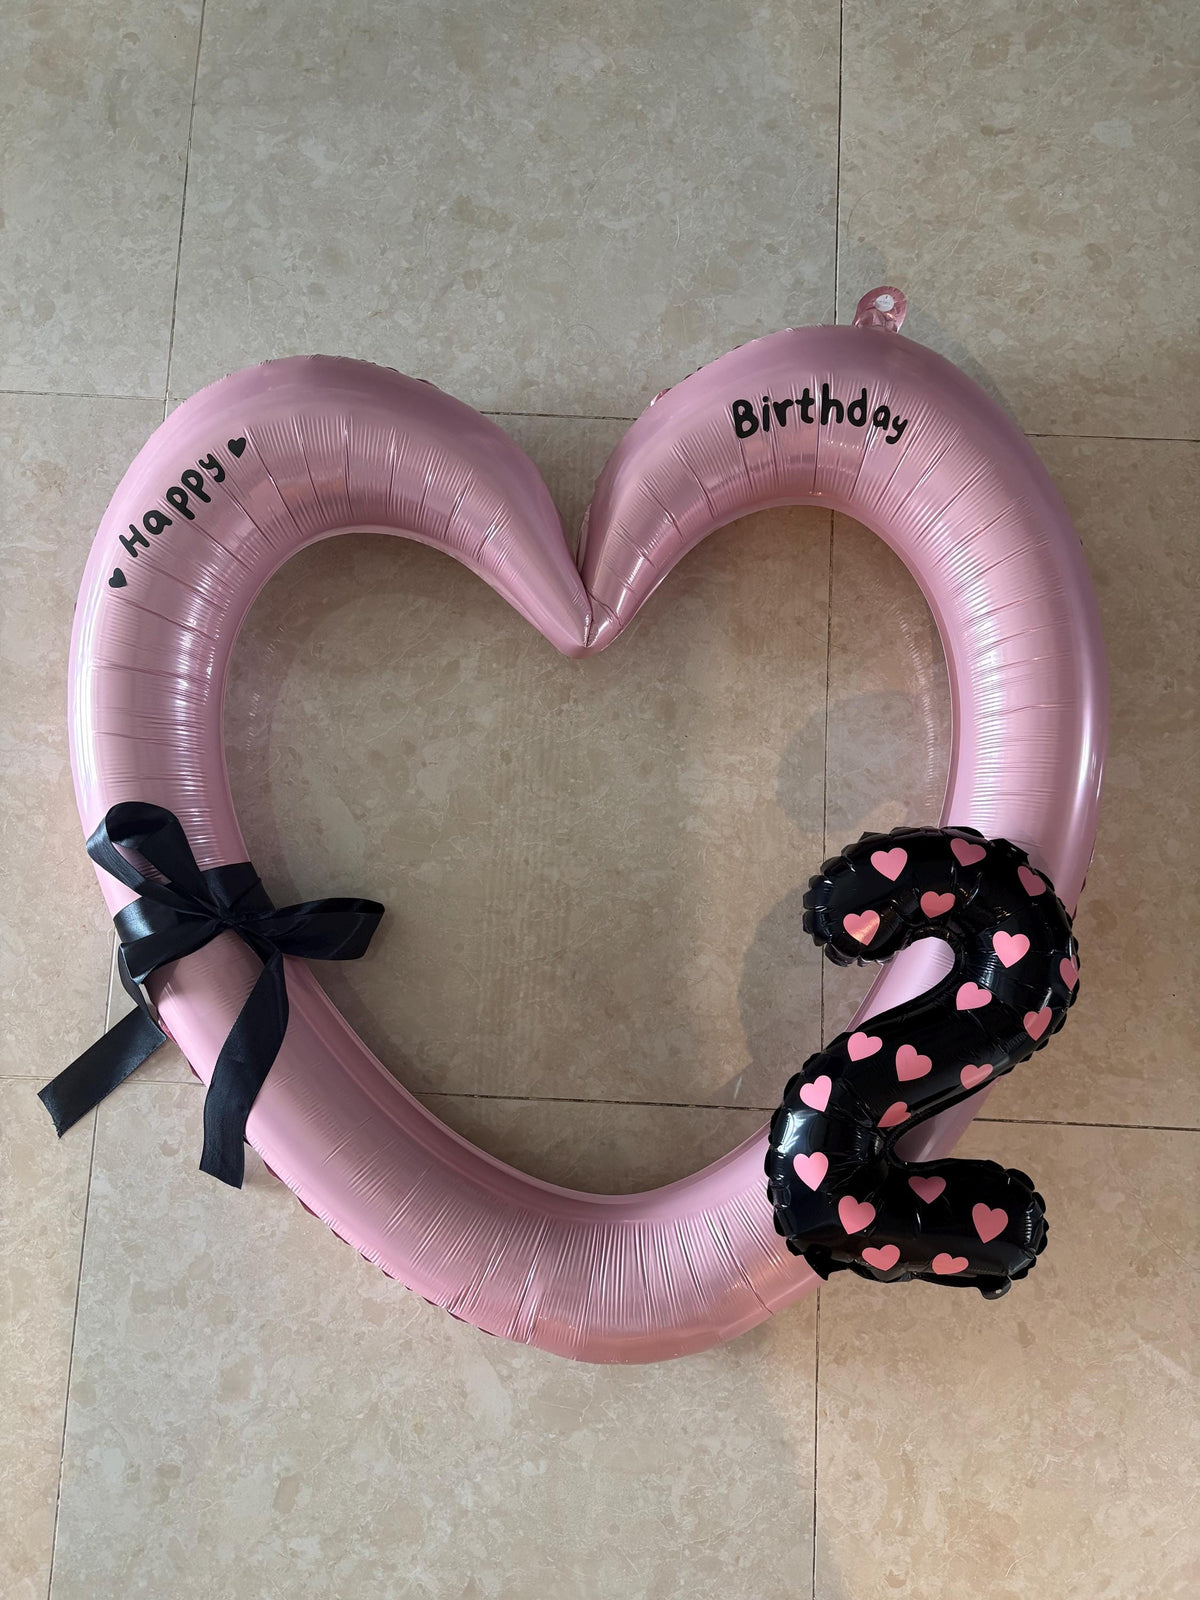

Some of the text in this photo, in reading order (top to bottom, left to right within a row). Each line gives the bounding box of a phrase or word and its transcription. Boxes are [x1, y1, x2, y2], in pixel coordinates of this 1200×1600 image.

[732, 382, 908, 444] Birthday
[118, 453, 225, 558] Happy
[764, 826, 1079, 1298] 2
